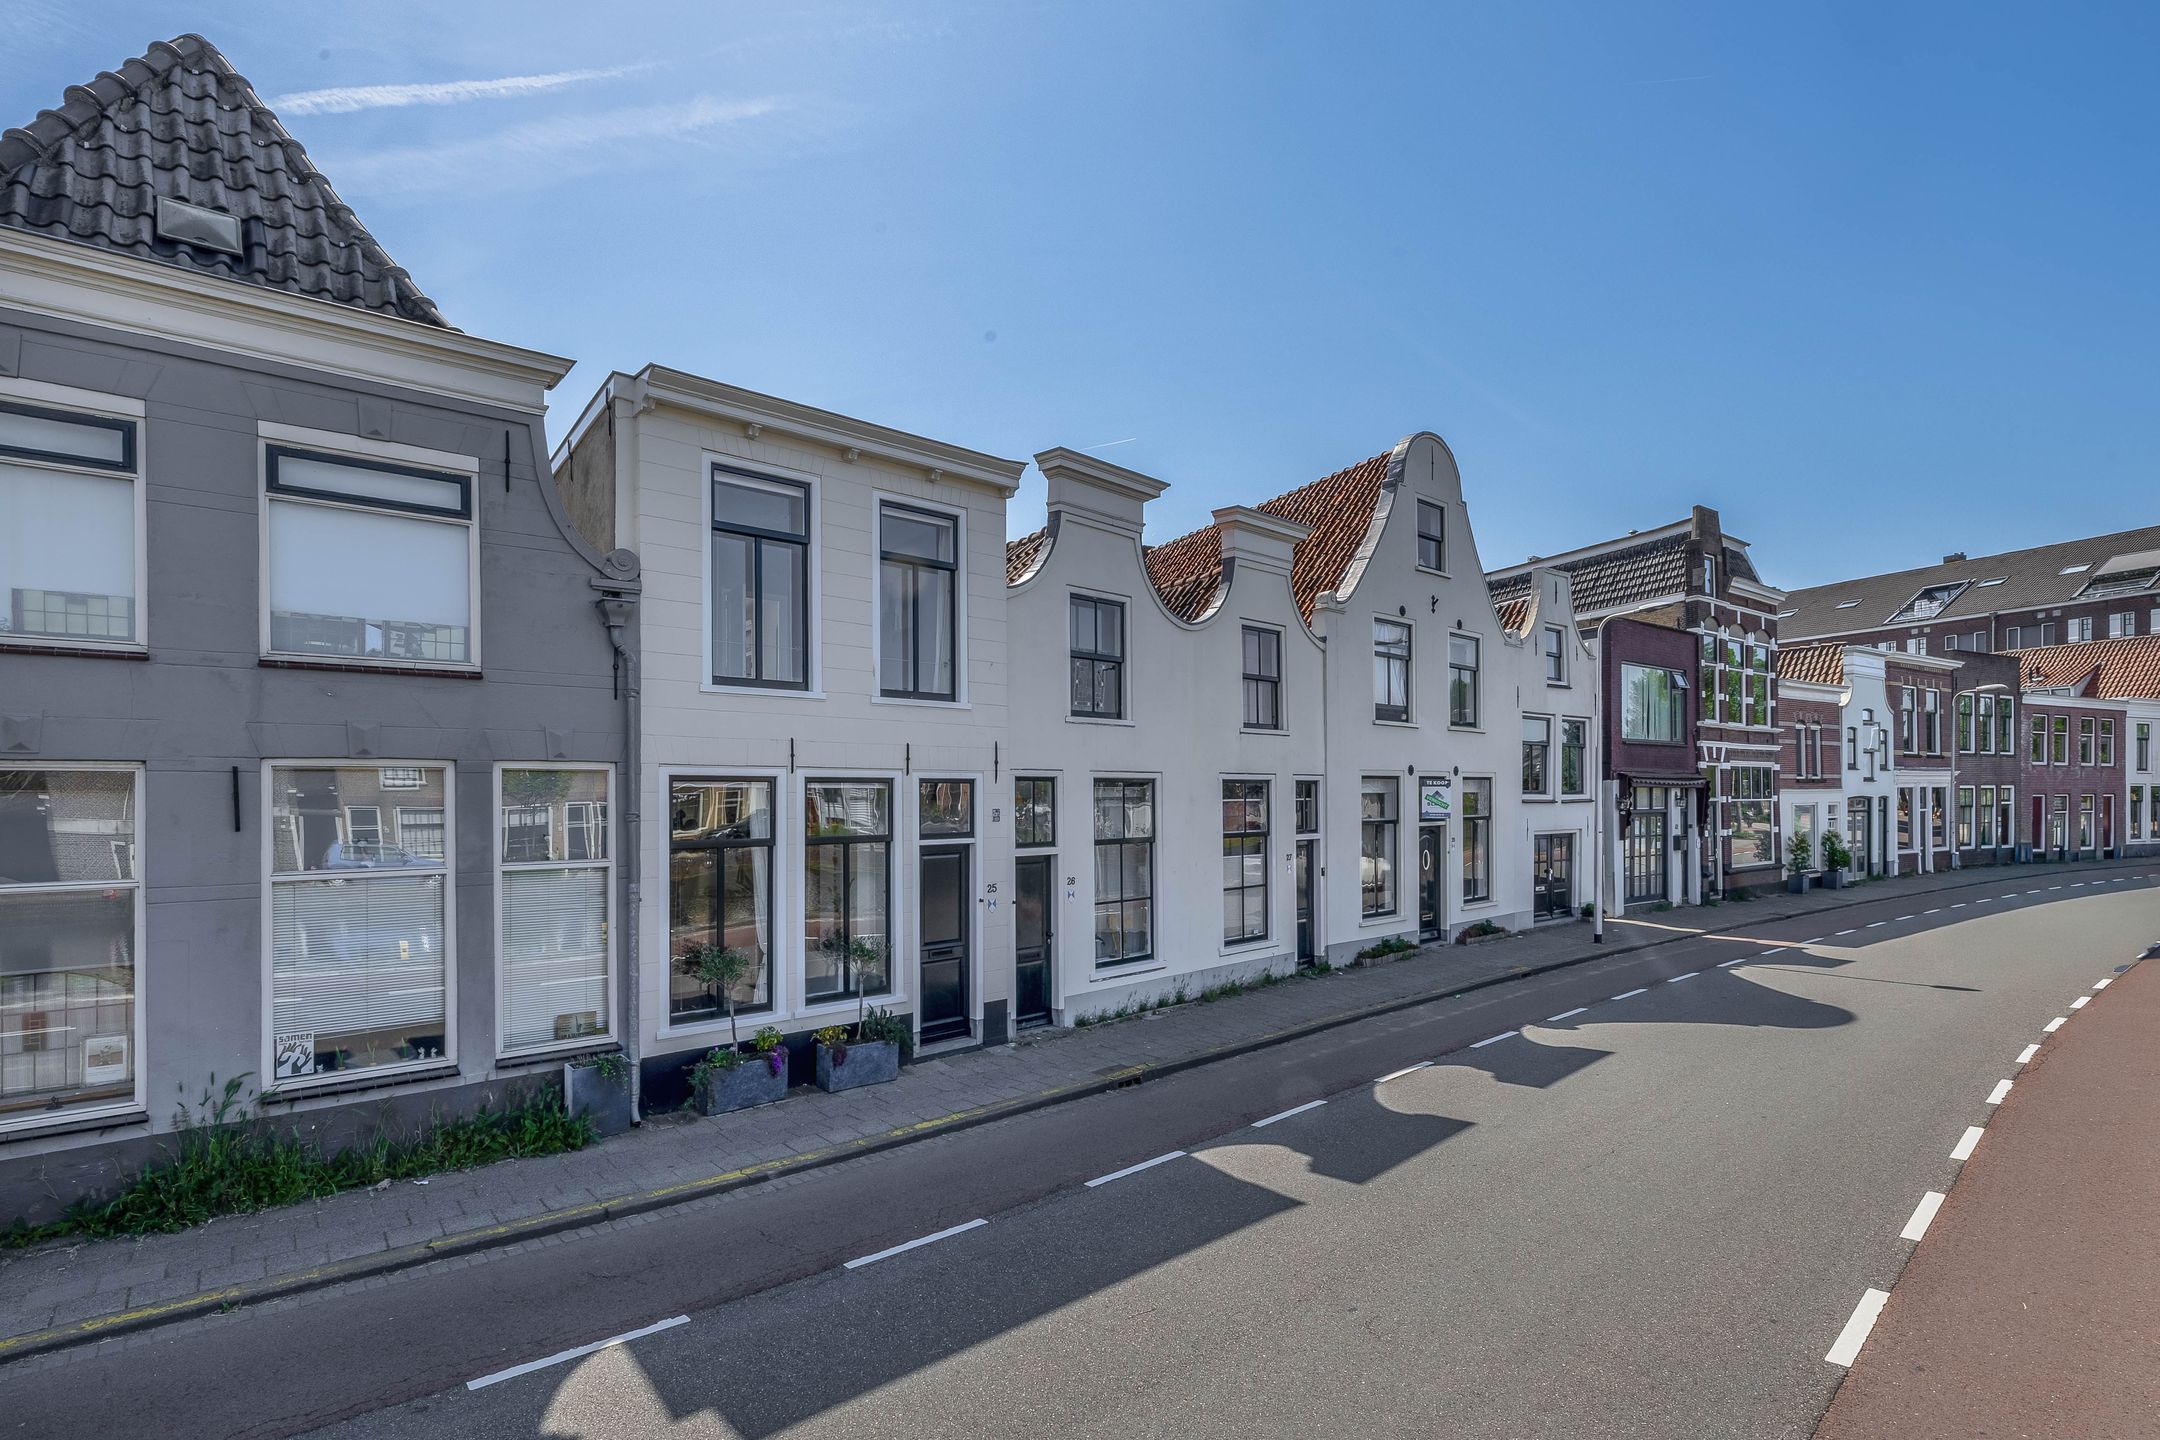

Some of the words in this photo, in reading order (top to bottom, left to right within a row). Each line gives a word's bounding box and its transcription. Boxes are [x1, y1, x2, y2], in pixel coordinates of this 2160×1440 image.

[1067, 877, 1075, 886] 26
[987, 883, 997, 893] 25
[279, 1033, 312, 1042] samen
